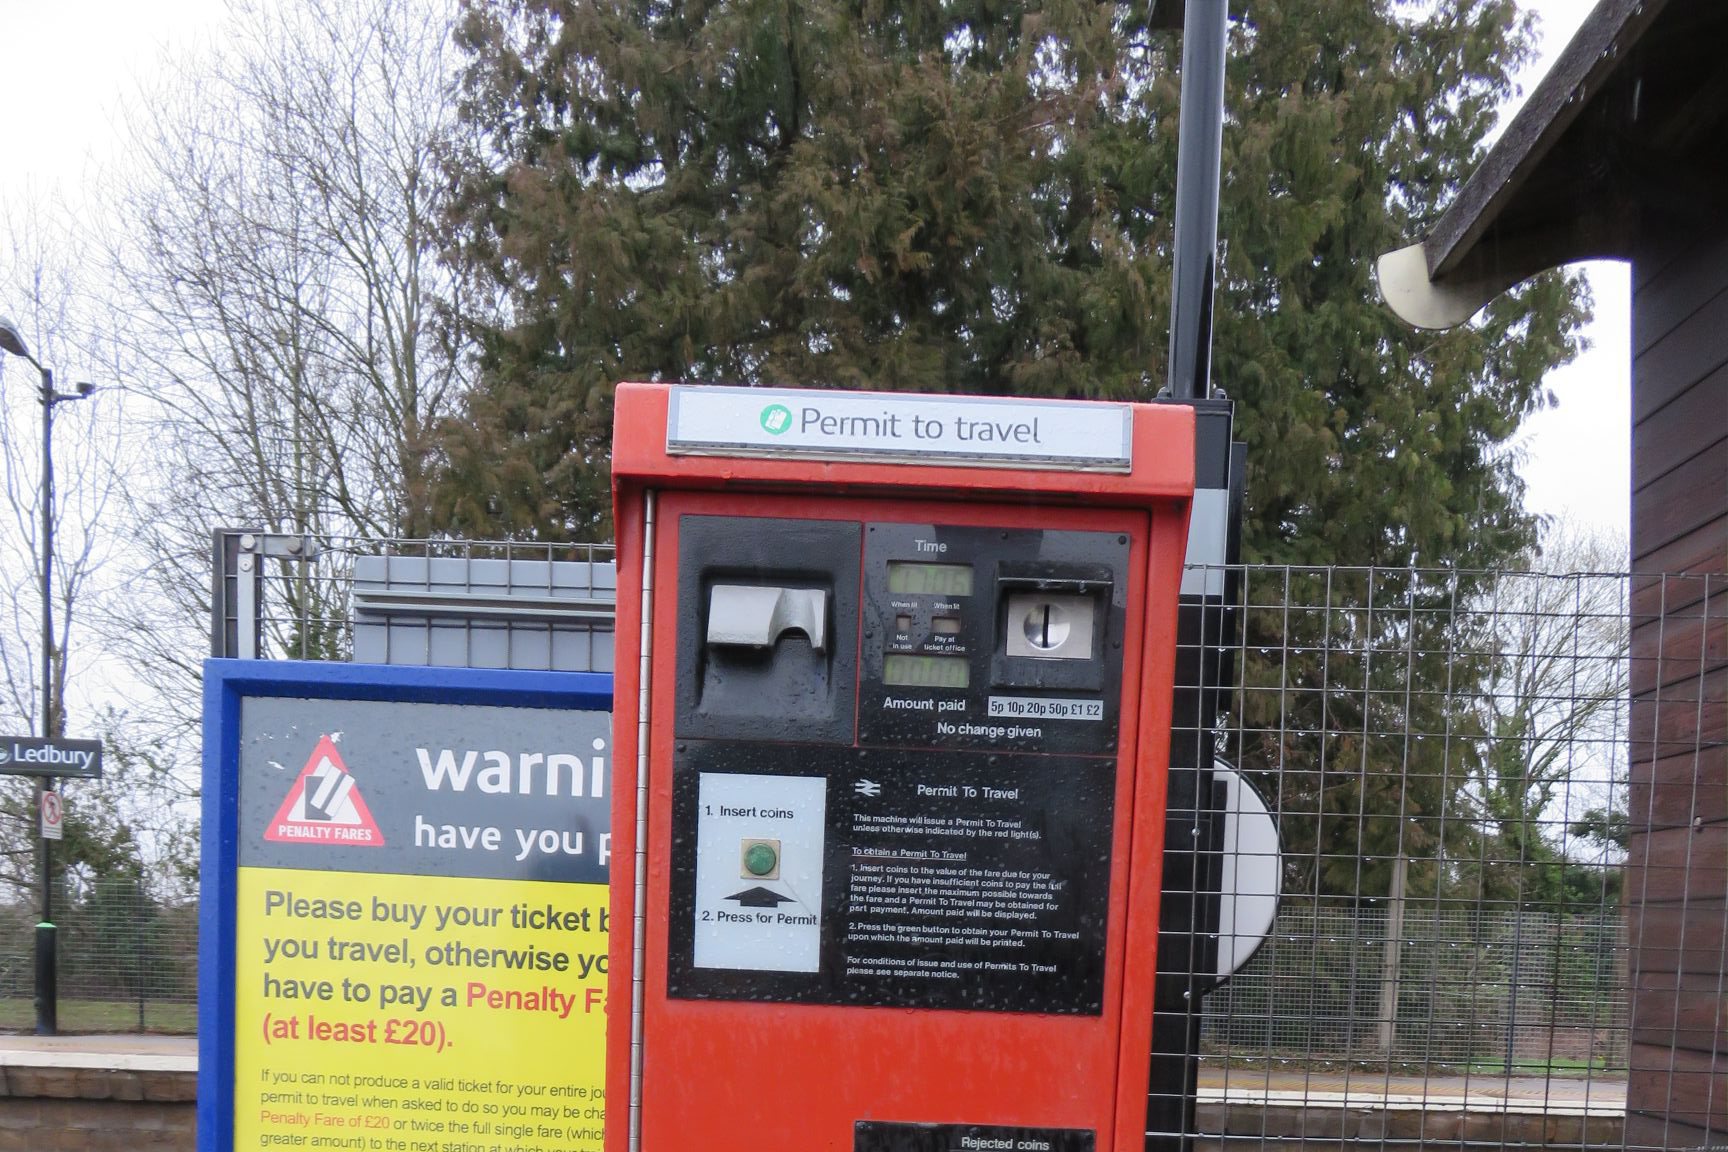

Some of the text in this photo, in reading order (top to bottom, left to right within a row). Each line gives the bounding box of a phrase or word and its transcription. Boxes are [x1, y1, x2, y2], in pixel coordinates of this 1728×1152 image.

[801, 408, 1040, 444] Permit to travel
[916, 540, 947, 552] Time
[934, 636, 946, 644] Pay
[883, 697, 965, 713] Amount paid
[991, 702, 1003, 715] 5p
[1008, 702, 1024, 715] 10p
[1027, 703, 1046, 716] 20p
[1049, 704, 1067, 717] 50p
[958, 723, 1004, 738] change
[1007, 725, 1041, 739] given
[14, 744, 94, 770] Ledbury
[917, 785, 957, 796] Permit
[982, 787, 1018, 799] Travel
[720, 805, 756, 818] Insert
[760, 806, 793, 819] coins
[854, 814, 871, 822] This
[872, 815, 907, 823] machine
[908, 816, 922, 824] will
[923, 817, 945, 825] issue
[955, 818, 983, 826] Permit
[997, 820, 1021, 828] Travel
[278, 825, 371, 840] PENALTY FARES
[415, 816, 500, 851] have
[515, 828, 582, 861] you
[852, 824, 880, 832] unless
[881, 826, 923, 834] otherwise
[925, 827, 963, 835] indicated
[1010, 831, 1040, 840] light(s).
[862, 848, 891, 856] obtain
[898, 850, 929, 858] Permit
[939, 851, 966, 859] Travel
[265, 891, 362, 920] Please
[372, 896, 426, 929] buy
[435, 905, 502, 933] your
[510, 902, 590, 931] ticket
[702, 910, 816, 925] 2. Press for Permit
[857, 923, 881, 931] Press
[897, 926, 921, 934] green
[922, 925, 949, 934] button
[961, 927, 987, 935] obtain
[989, 930, 1008, 938] your
[1010, 929, 1038, 937] Permit
[1054, 931, 1079, 939] Travel
[264, 940, 318, 967] you
[328, 936, 415, 971] travel,
[425, 940, 569, 972] otherwise
[846, 967, 873, 977] please
[893, 970, 929, 979] separate
[931, 970, 959, 978] notice.
[264, 973, 333, 1001] have
[342, 980, 370, 1003] to
[380, 985, 431, 1011] pay
[441, 988, 456, 1007] a
[467, 982, 575, 1018] Penalty
[263, 1014, 452, 1052] (at least £20).
[961, 1137, 1049, 1152] Rejected coins
